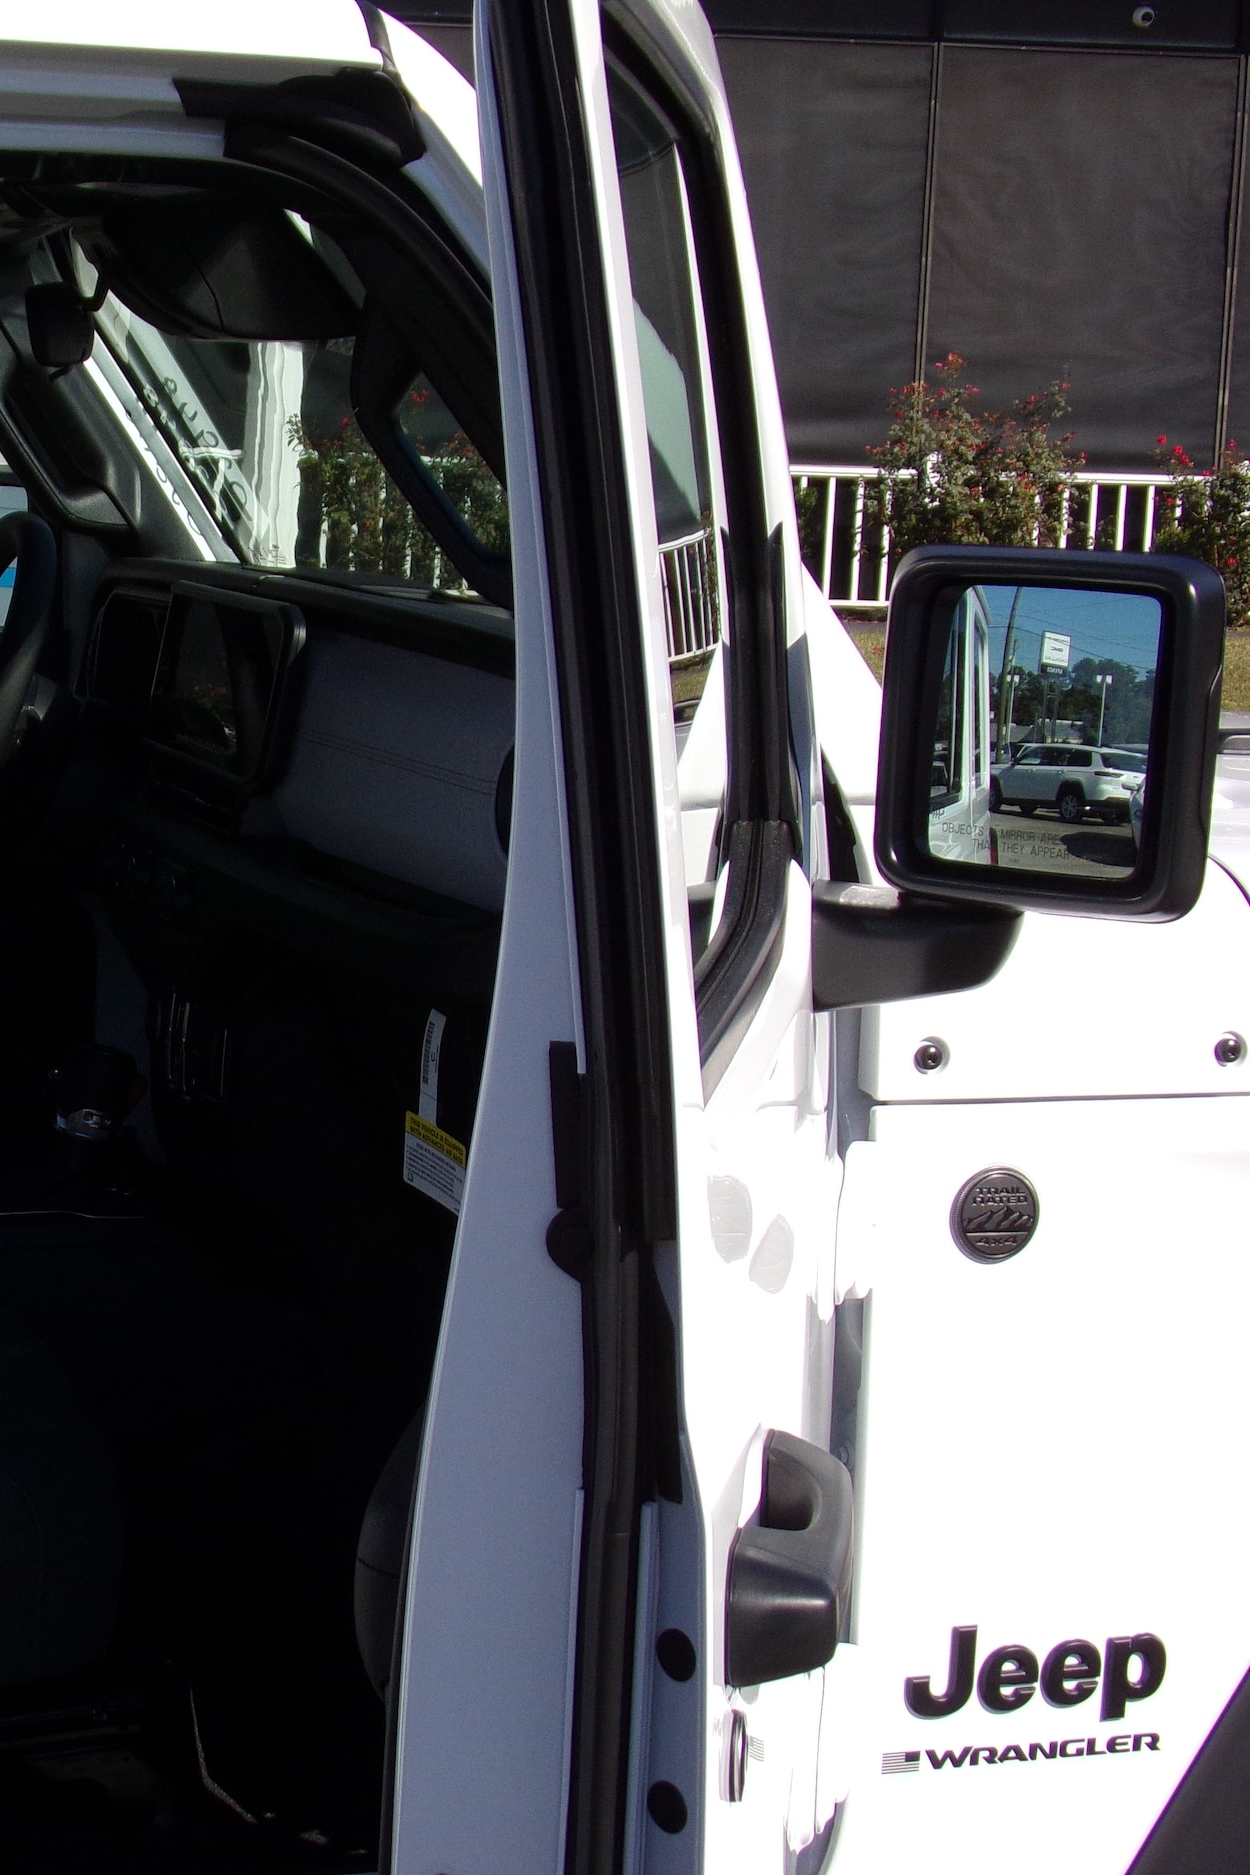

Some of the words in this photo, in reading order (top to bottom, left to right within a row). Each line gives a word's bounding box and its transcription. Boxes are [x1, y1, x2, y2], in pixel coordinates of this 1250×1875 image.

[941, 822, 984, 837] OBJECTS
[1000, 829, 1035, 841] MIRROR
[1040, 833, 1060, 845] ARE
[972, 838, 991, 851] THA
[1001, 842, 1028, 854] THEY
[1029, 846, 1070, 860] APPEAR
[972, 1196, 1028, 1206] RATED
[975, 1186, 1026, 1197] TRAIL
[903, 1624, 1167, 1722] Jeep
[925, 1732, 1161, 1770] WRANGLER
